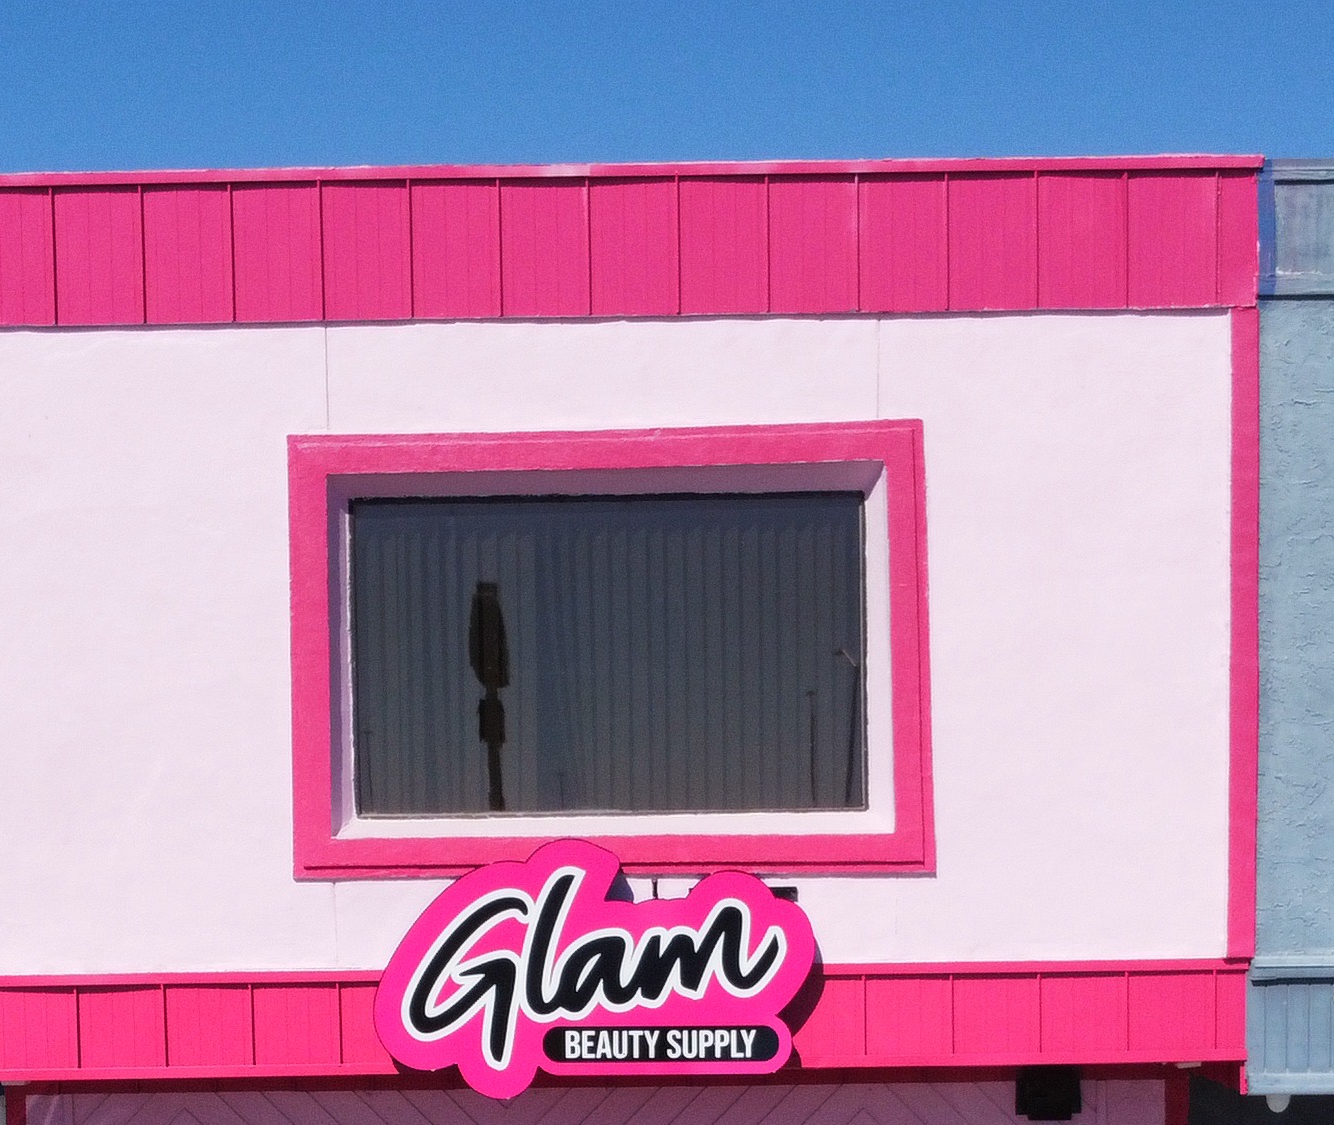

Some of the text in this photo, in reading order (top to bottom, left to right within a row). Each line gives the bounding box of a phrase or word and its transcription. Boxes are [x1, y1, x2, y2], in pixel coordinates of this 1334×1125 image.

[401, 866, 787, 1070] Glam
[564, 1029, 757, 1059] BEAUTY SUPPLY
